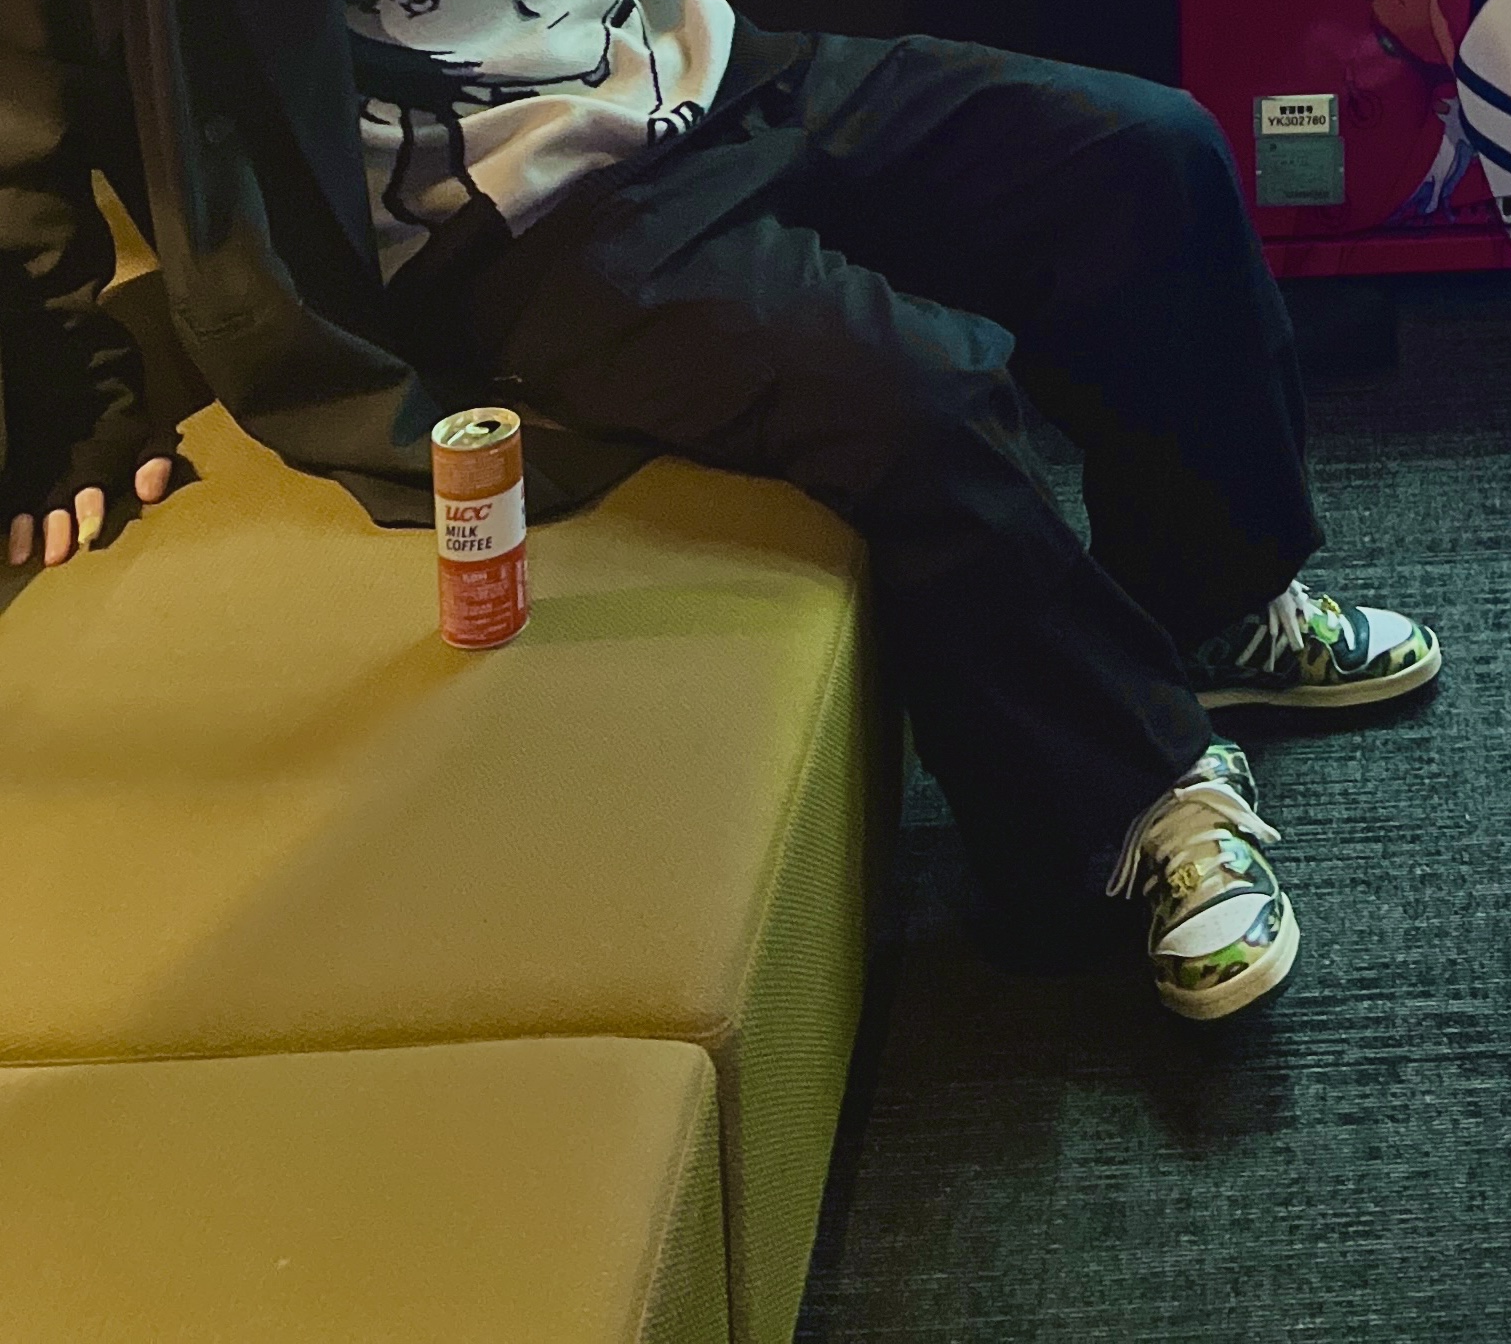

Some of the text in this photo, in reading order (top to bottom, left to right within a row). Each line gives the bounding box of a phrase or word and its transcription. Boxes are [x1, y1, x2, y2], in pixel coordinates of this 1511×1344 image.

[445, 502, 492, 523] UCC
[445, 525, 479, 538] MILK
[446, 536, 492, 552] COFFEE
